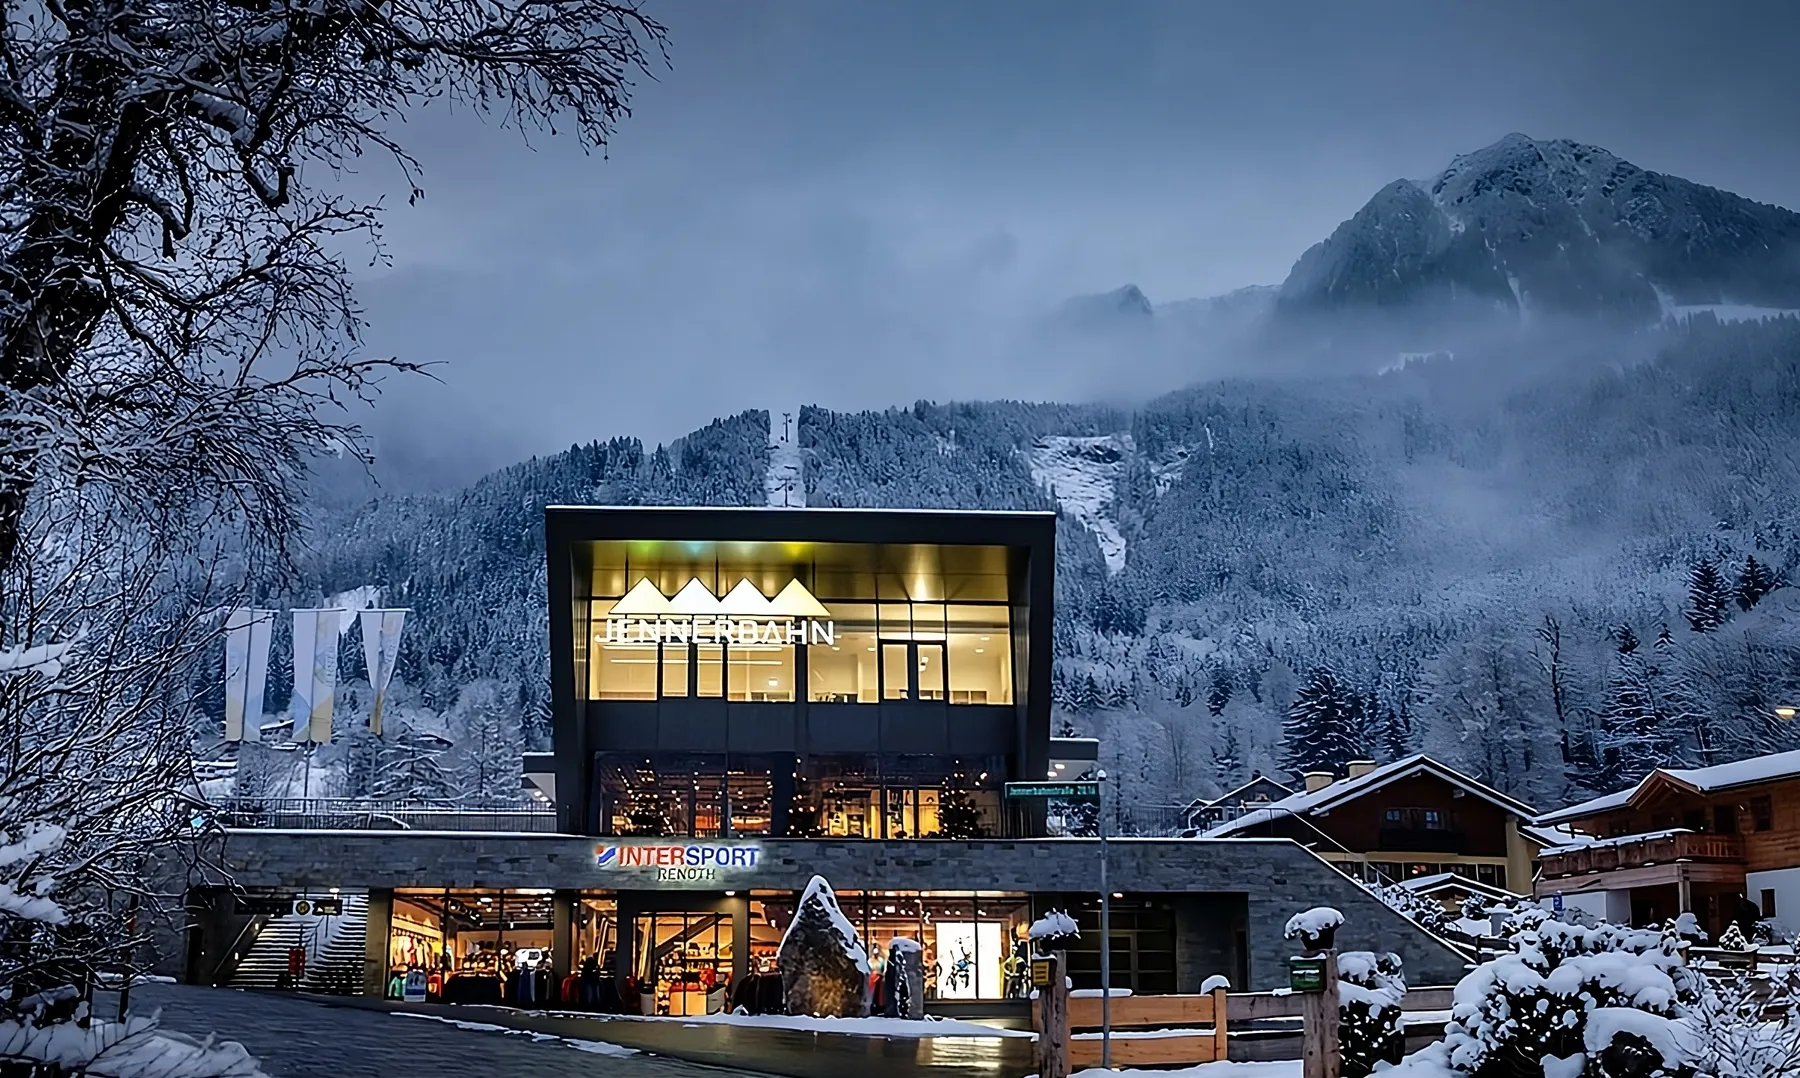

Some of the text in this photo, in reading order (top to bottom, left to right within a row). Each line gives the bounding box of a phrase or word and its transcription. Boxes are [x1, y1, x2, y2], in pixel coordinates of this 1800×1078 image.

[594, 618, 835, 645] JENNERBAHN
[618, 845, 759, 867] INTERSPORT
[658, 868, 715, 880] RENOTH
